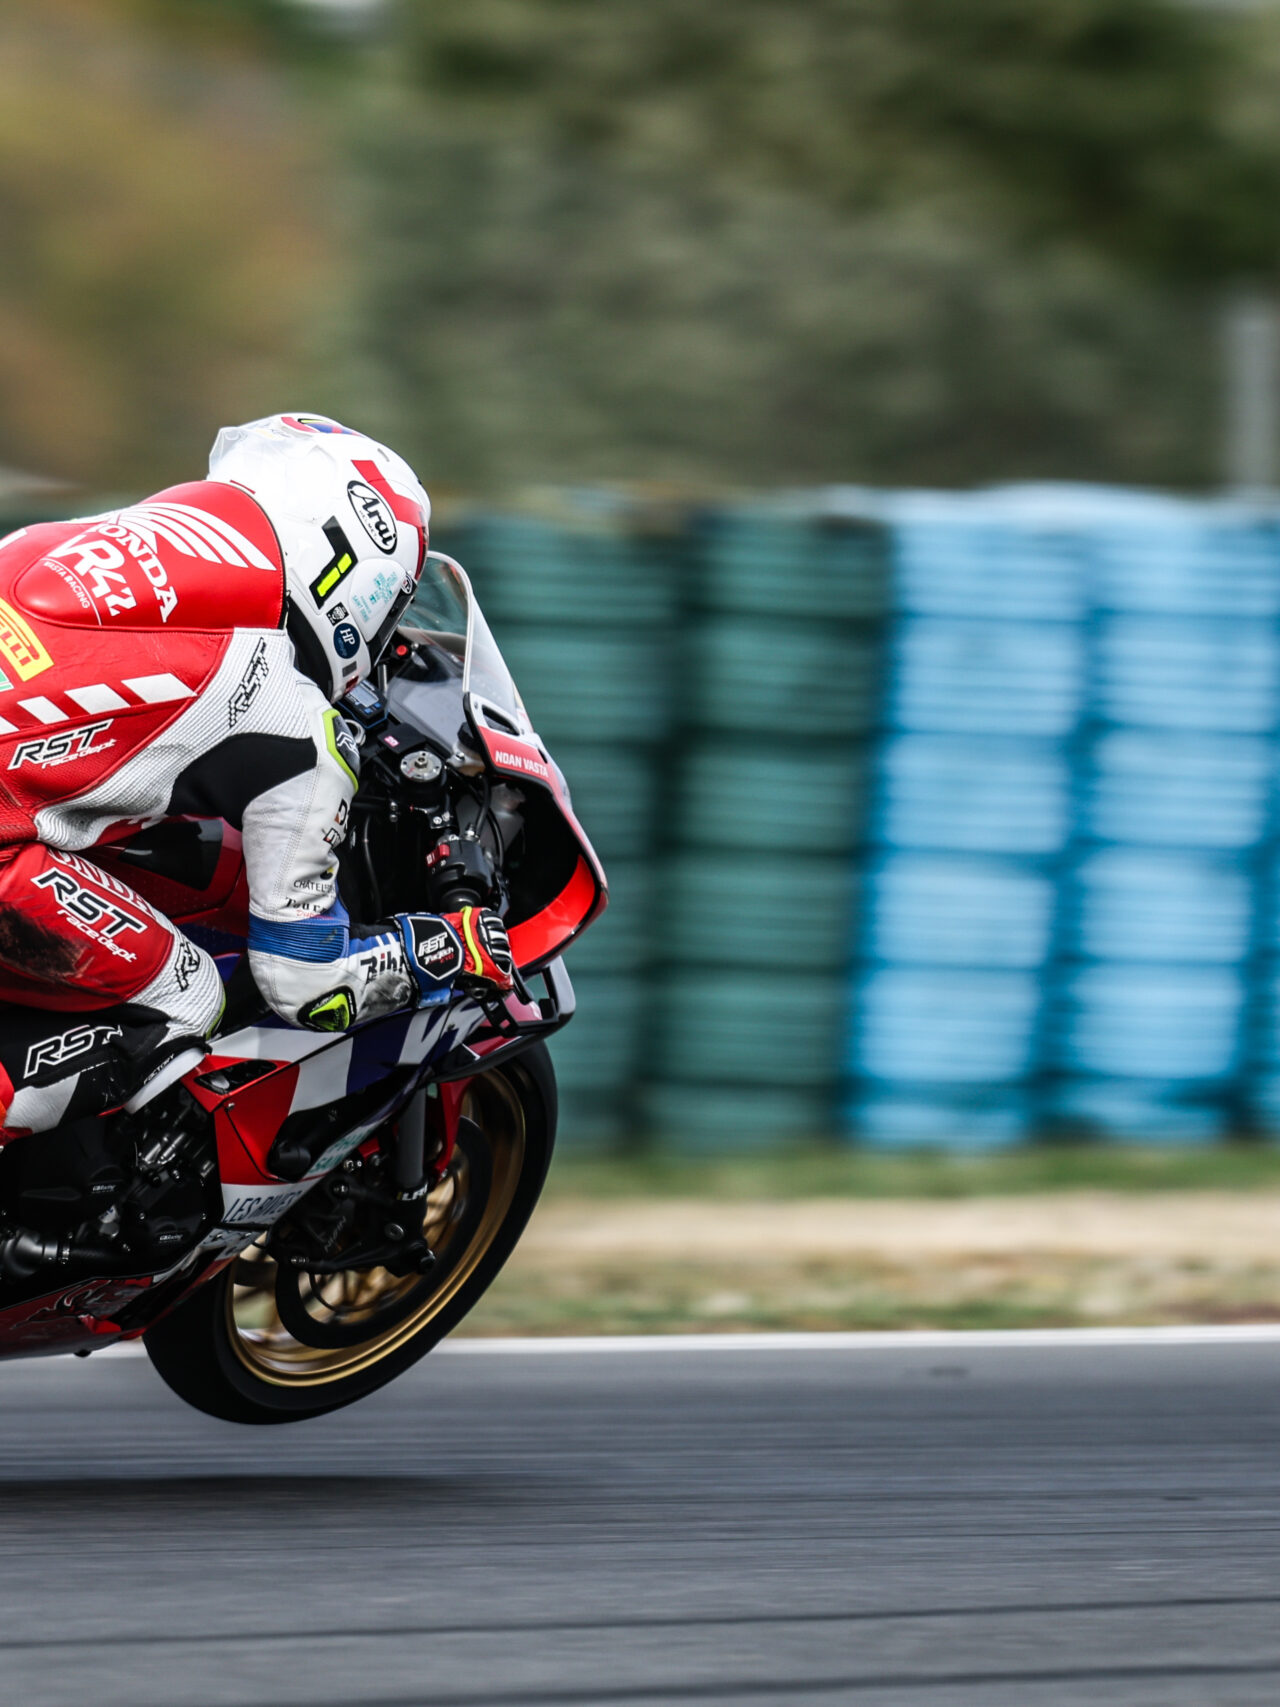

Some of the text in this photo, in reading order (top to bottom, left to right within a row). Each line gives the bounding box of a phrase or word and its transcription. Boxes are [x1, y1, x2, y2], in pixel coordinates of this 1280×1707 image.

[349, 489, 397, 546] Arai
[63, 574, 91, 609] RACING
[340, 628, 356, 645] HP
[6, 717, 115, 771] RST
[41, 738, 117, 770] race dept
[494, 749, 549, 777] NOAN VASTA
[30, 866, 148, 939] RST
[57, 908, 138, 963] race dept
[418, 932, 450, 958] RST
